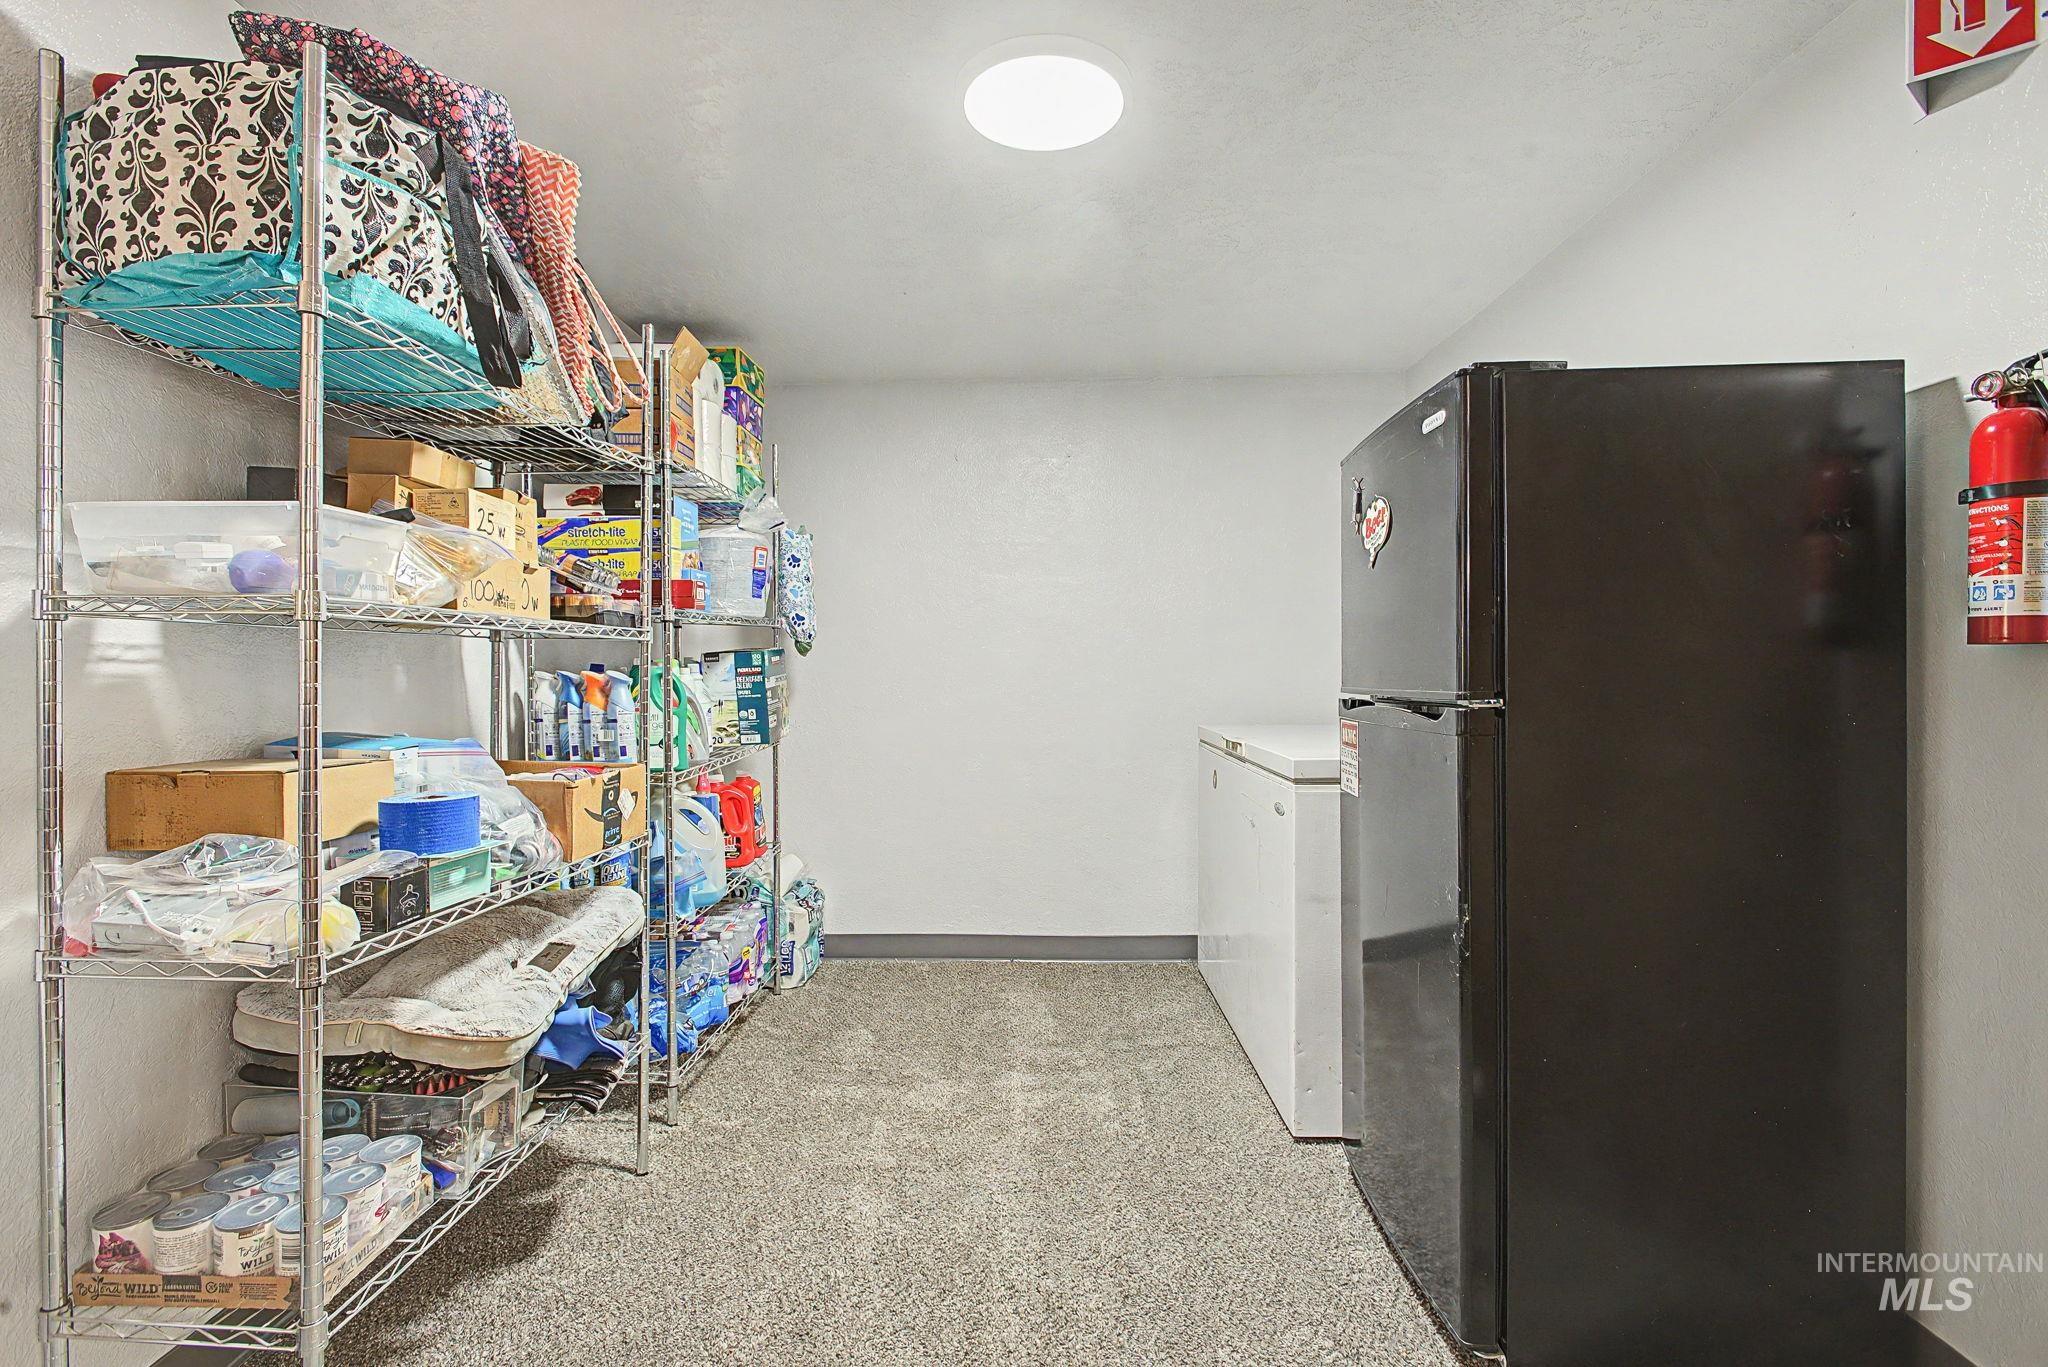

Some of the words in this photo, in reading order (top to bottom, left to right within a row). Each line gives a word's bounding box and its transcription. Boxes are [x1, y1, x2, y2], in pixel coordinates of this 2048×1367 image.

[476, 508, 495, 536] 25
[567, 527, 626, 537] stretch-tite
[470, 579, 495, 602] 100
[240, 1252, 274, 1270] WILD
[76, 1278, 122, 1300] Beyond
[124, 1283, 159, 1293] WILD
